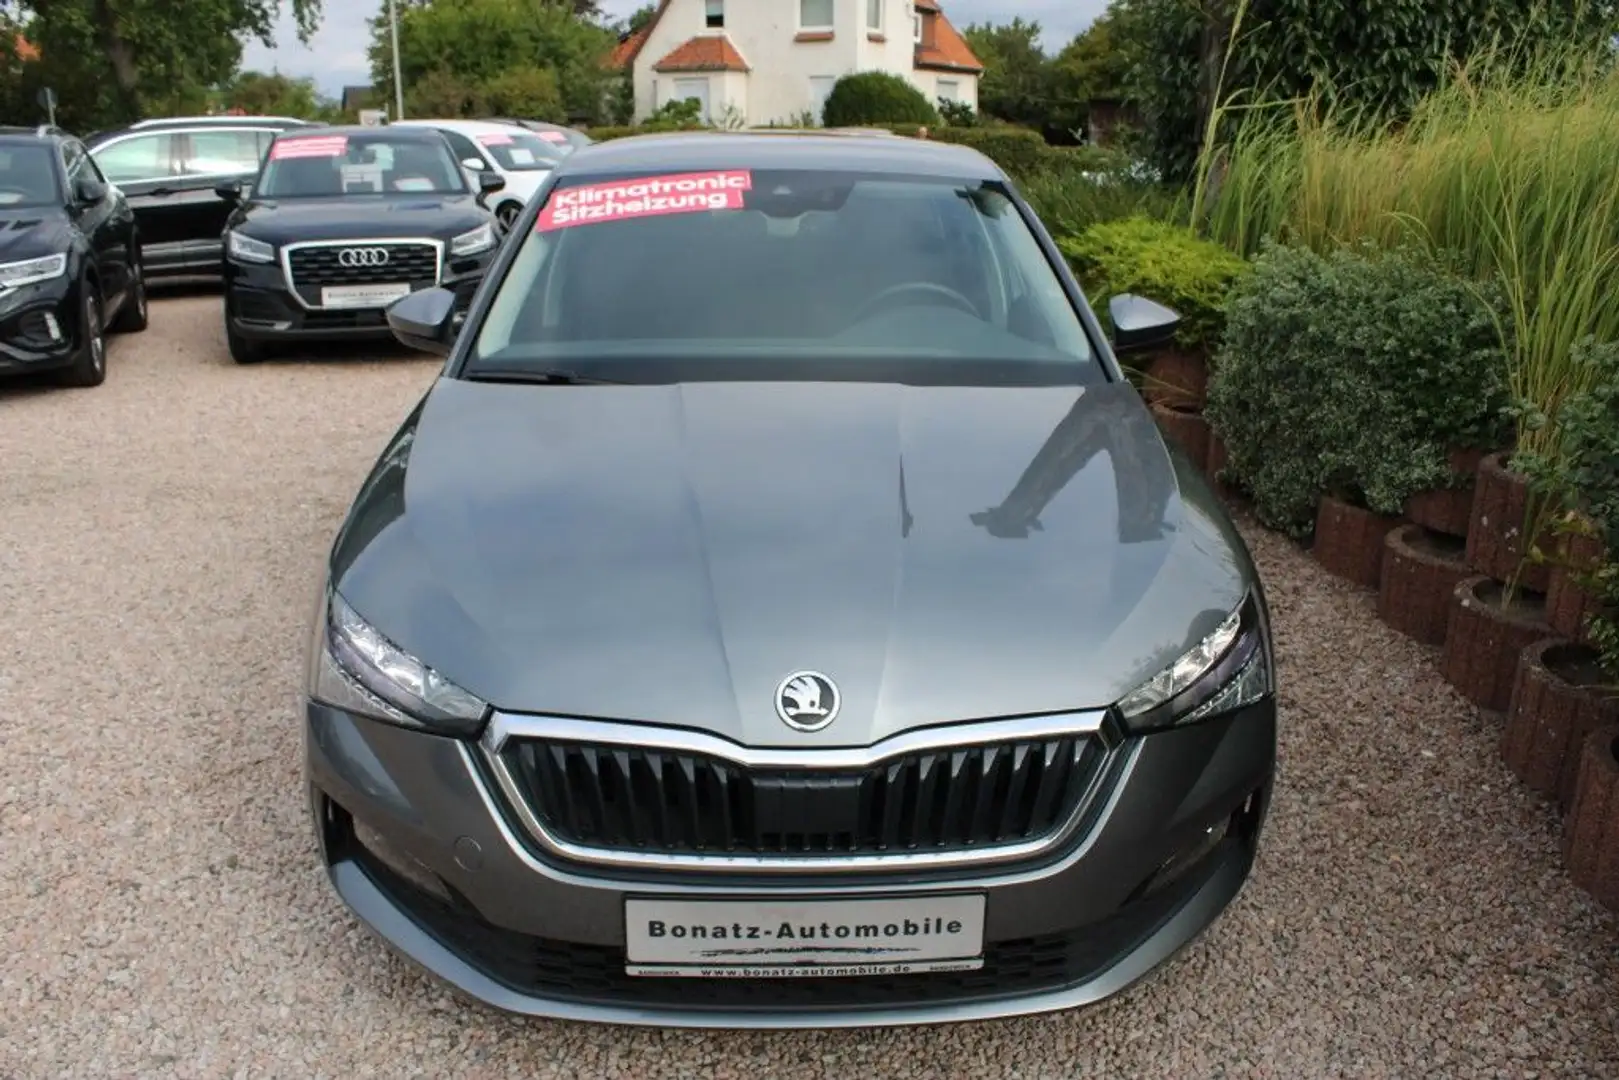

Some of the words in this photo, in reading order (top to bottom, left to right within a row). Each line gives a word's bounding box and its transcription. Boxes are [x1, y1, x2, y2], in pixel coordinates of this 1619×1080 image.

[556, 174, 744, 208] Klimatronic
[552, 192, 728, 224] Sitzheizung
[648, 917, 963, 940] Bonatz-Automobile
[701, 965, 911, 977] www.bonatz-automobile.de
